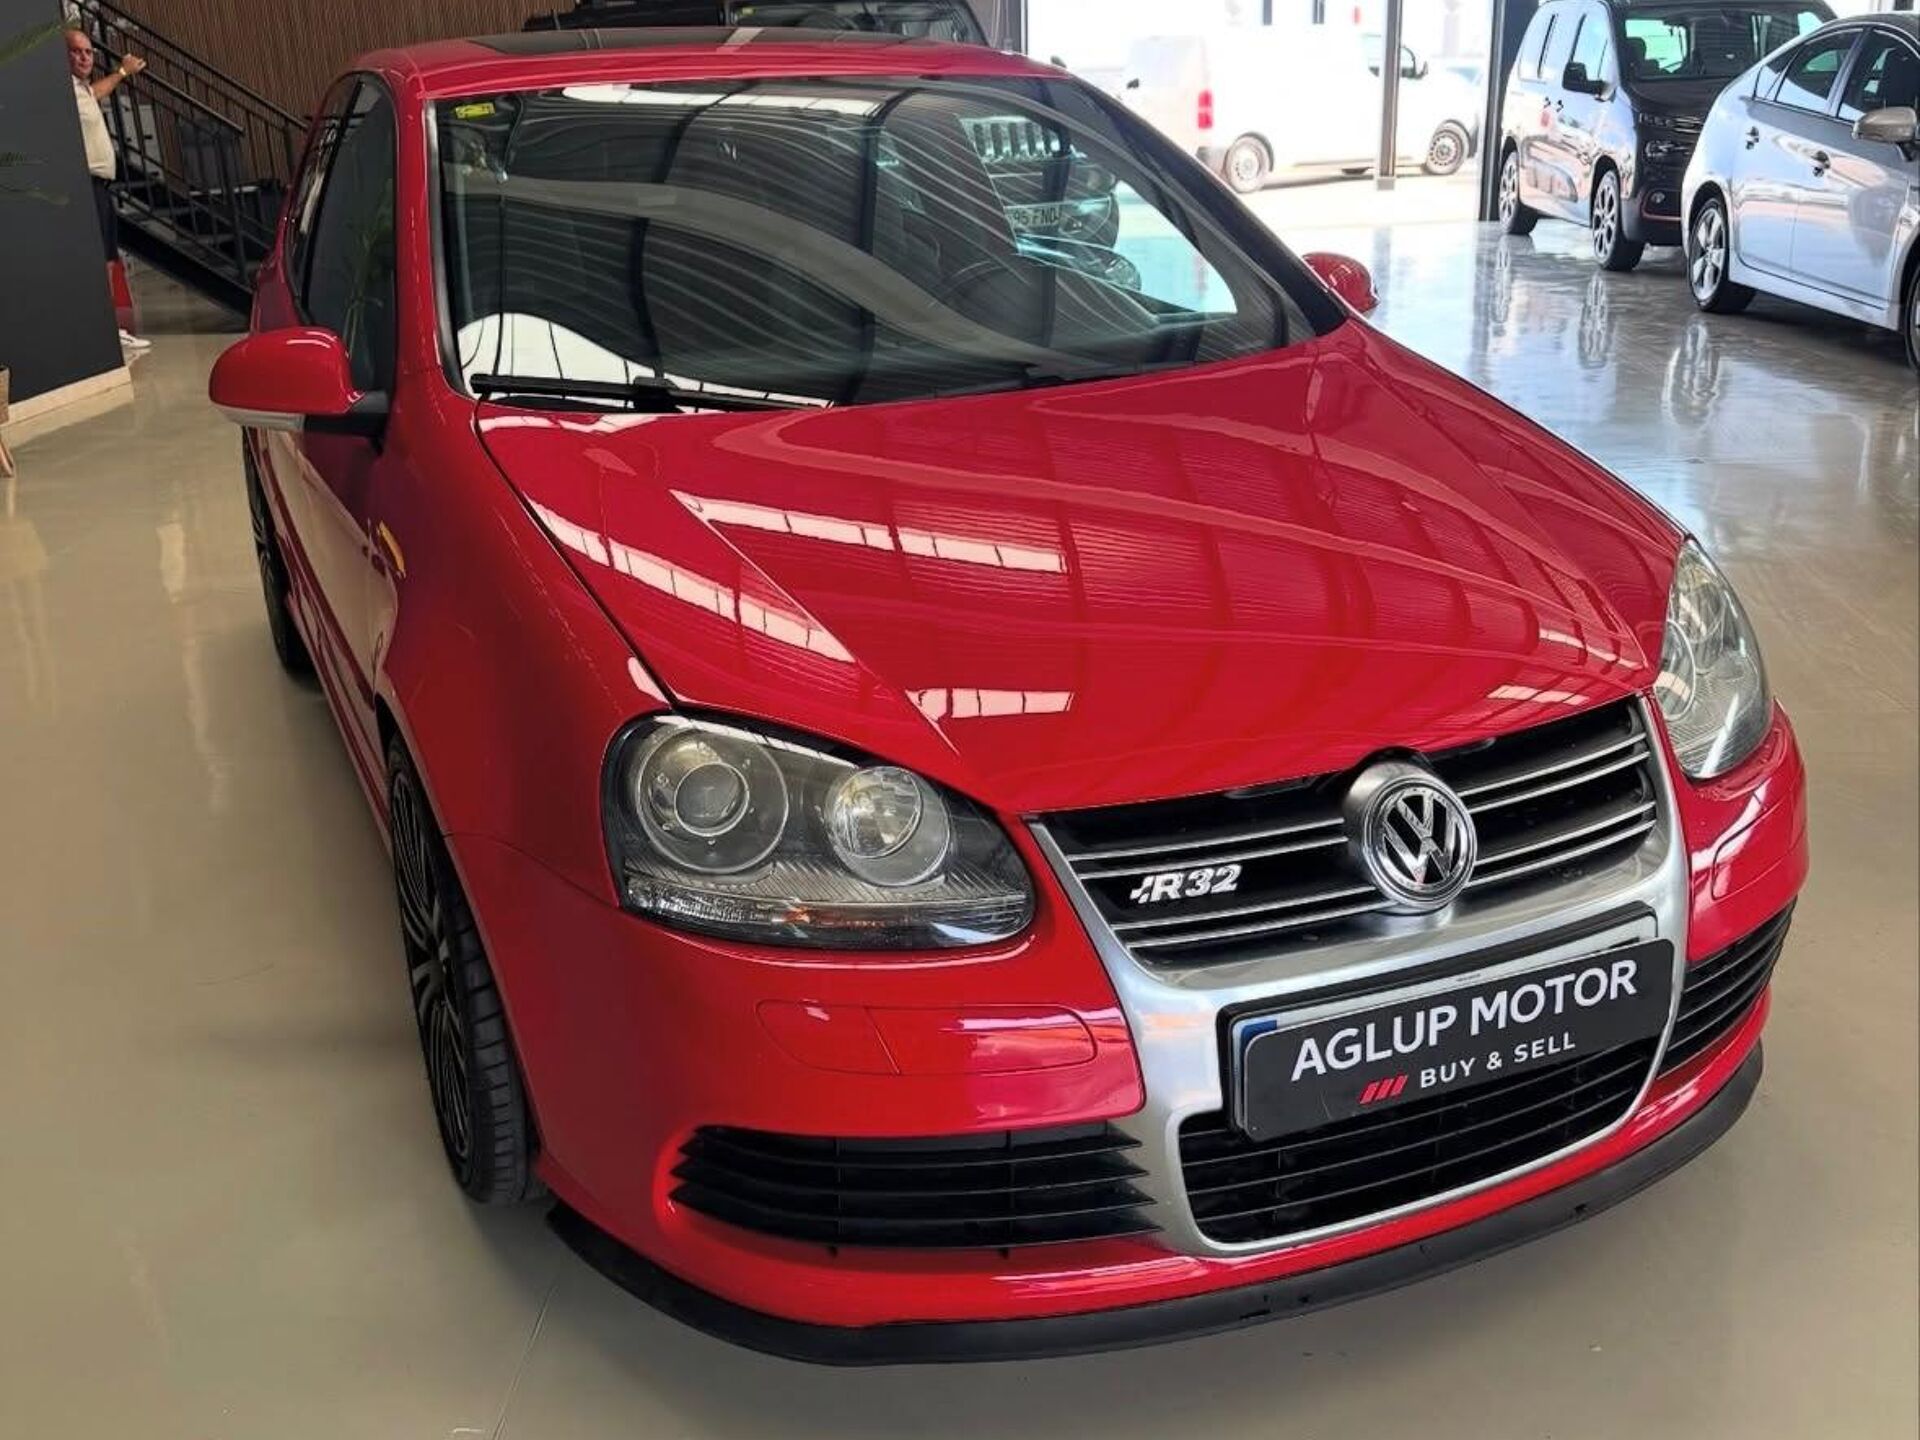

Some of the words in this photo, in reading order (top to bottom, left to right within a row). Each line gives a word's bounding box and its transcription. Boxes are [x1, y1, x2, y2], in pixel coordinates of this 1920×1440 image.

[1147, 863, 1242, 903] R32
[1290, 1004, 1458, 1083] AGLUP
[1470, 959, 1638, 1036] MOTOR
[1420, 1057, 1476, 1089] BUY
[1486, 1051, 1502, 1071] &
[1513, 1031, 1577, 1063] SELL
